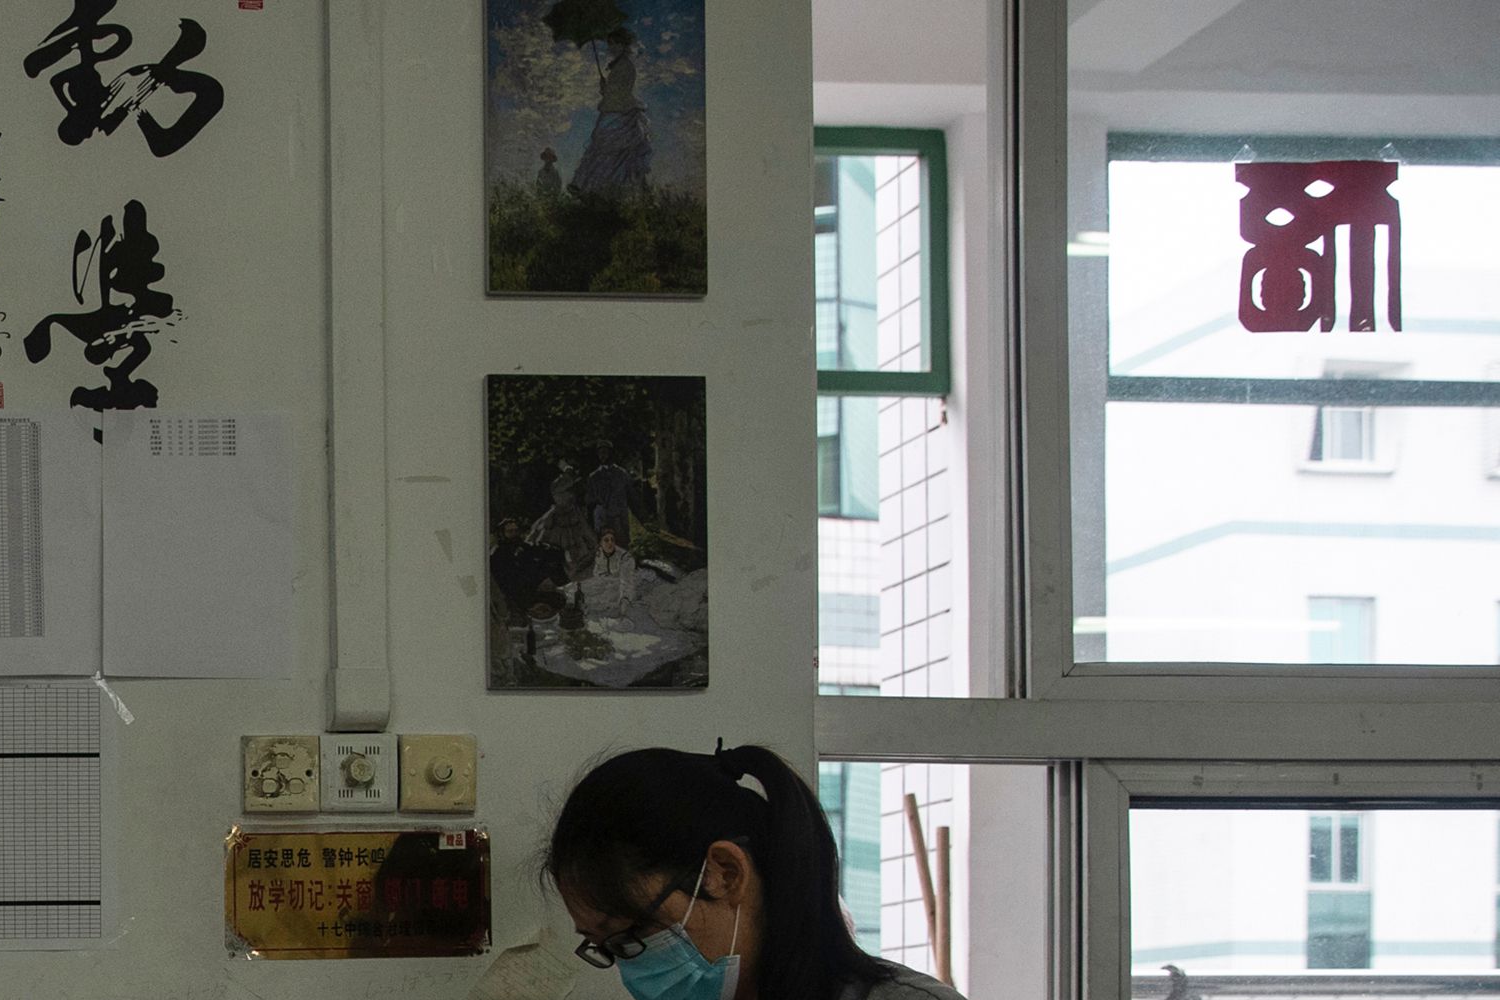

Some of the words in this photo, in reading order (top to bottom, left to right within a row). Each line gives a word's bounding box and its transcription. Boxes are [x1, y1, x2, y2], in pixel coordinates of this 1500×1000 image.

[247, 848, 312, 868] 居安思危
[322, 847, 386, 868] 警钟长鸣
